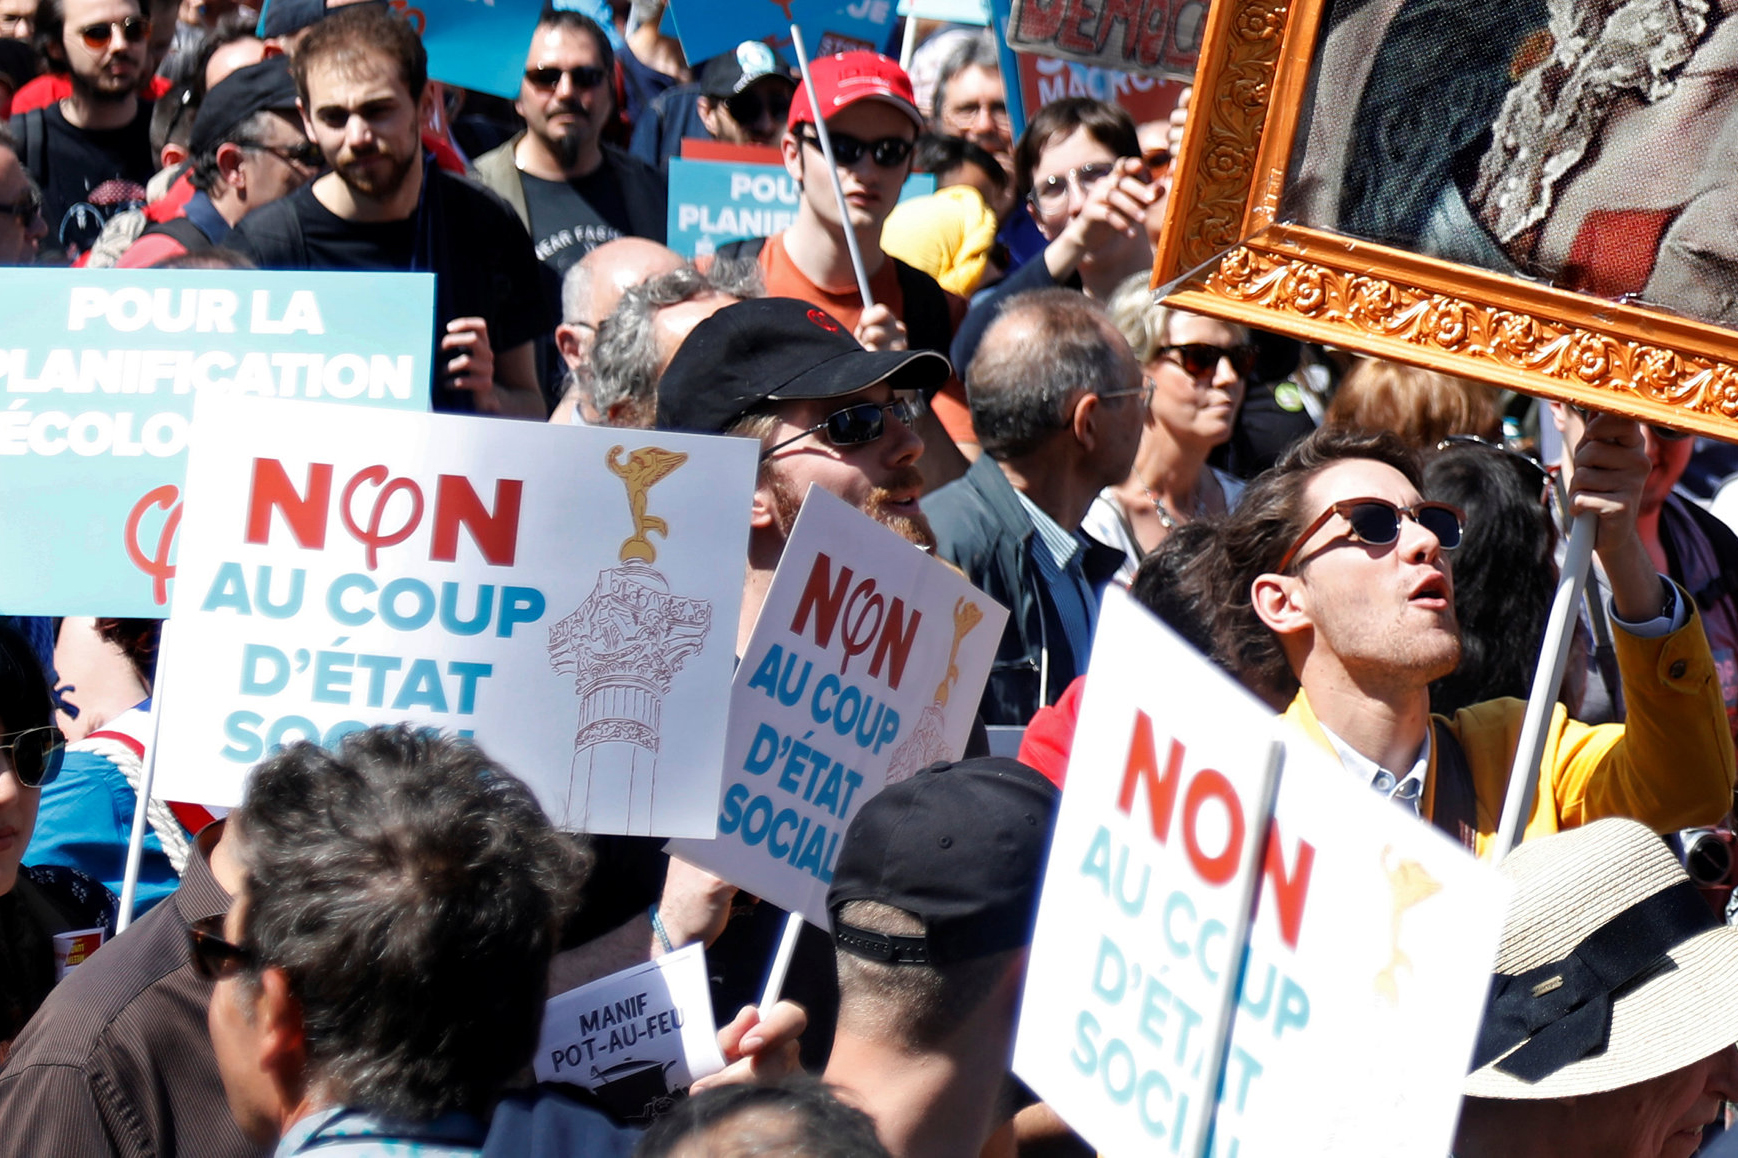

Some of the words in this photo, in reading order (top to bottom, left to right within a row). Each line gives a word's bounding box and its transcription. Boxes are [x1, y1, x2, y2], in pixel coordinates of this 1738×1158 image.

[68, 288, 237, 334] POUR
[250, 290, 325, 335] LA
[200, 561, 306, 620] AU
[325, 573, 547, 638] COUP
[747, 643, 808, 709] AU
[811, 673, 900, 756] COUP
[718, 783, 844, 885] SOCIAL
[1079, 824, 1151, 917] AU
[1116, 707, 1316, 953] NON
[551, 1008, 685, 1073] POT-AU-FEU
[578, 993, 648, 1036] MANIF
